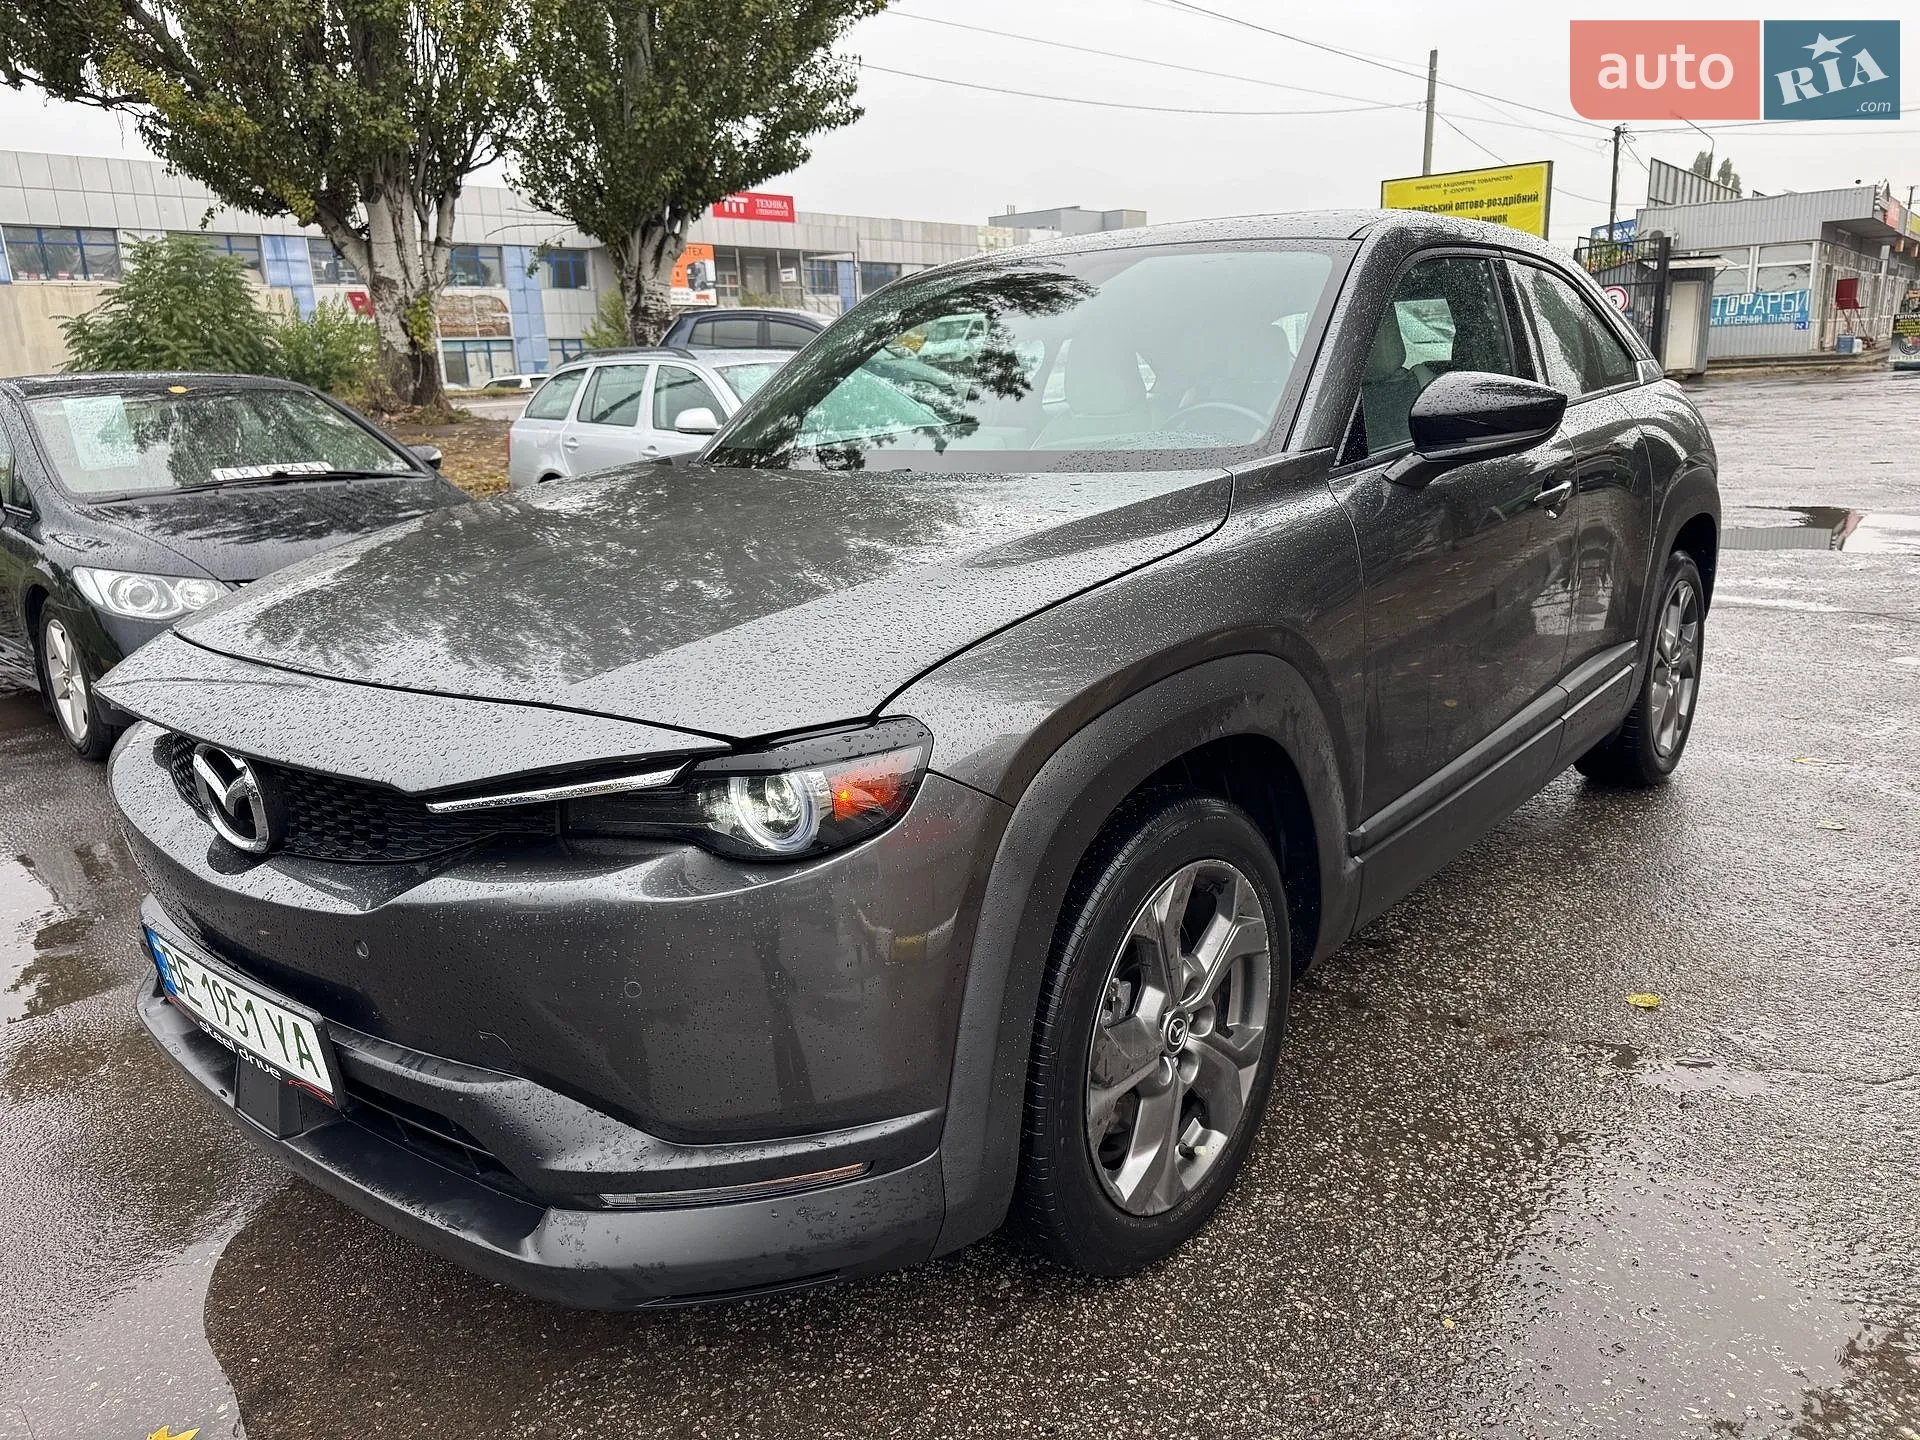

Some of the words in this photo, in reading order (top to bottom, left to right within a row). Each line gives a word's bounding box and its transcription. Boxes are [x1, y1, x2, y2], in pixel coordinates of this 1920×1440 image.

[1610, 295, 1618, 306] 5
[160, 943, 203, 1009] BE
[200, 972, 267, 1050] 1951
[264, 1005, 322, 1080] YA
[198, 1019, 238, 1054] steel
[237, 1046, 282, 1081] drive
